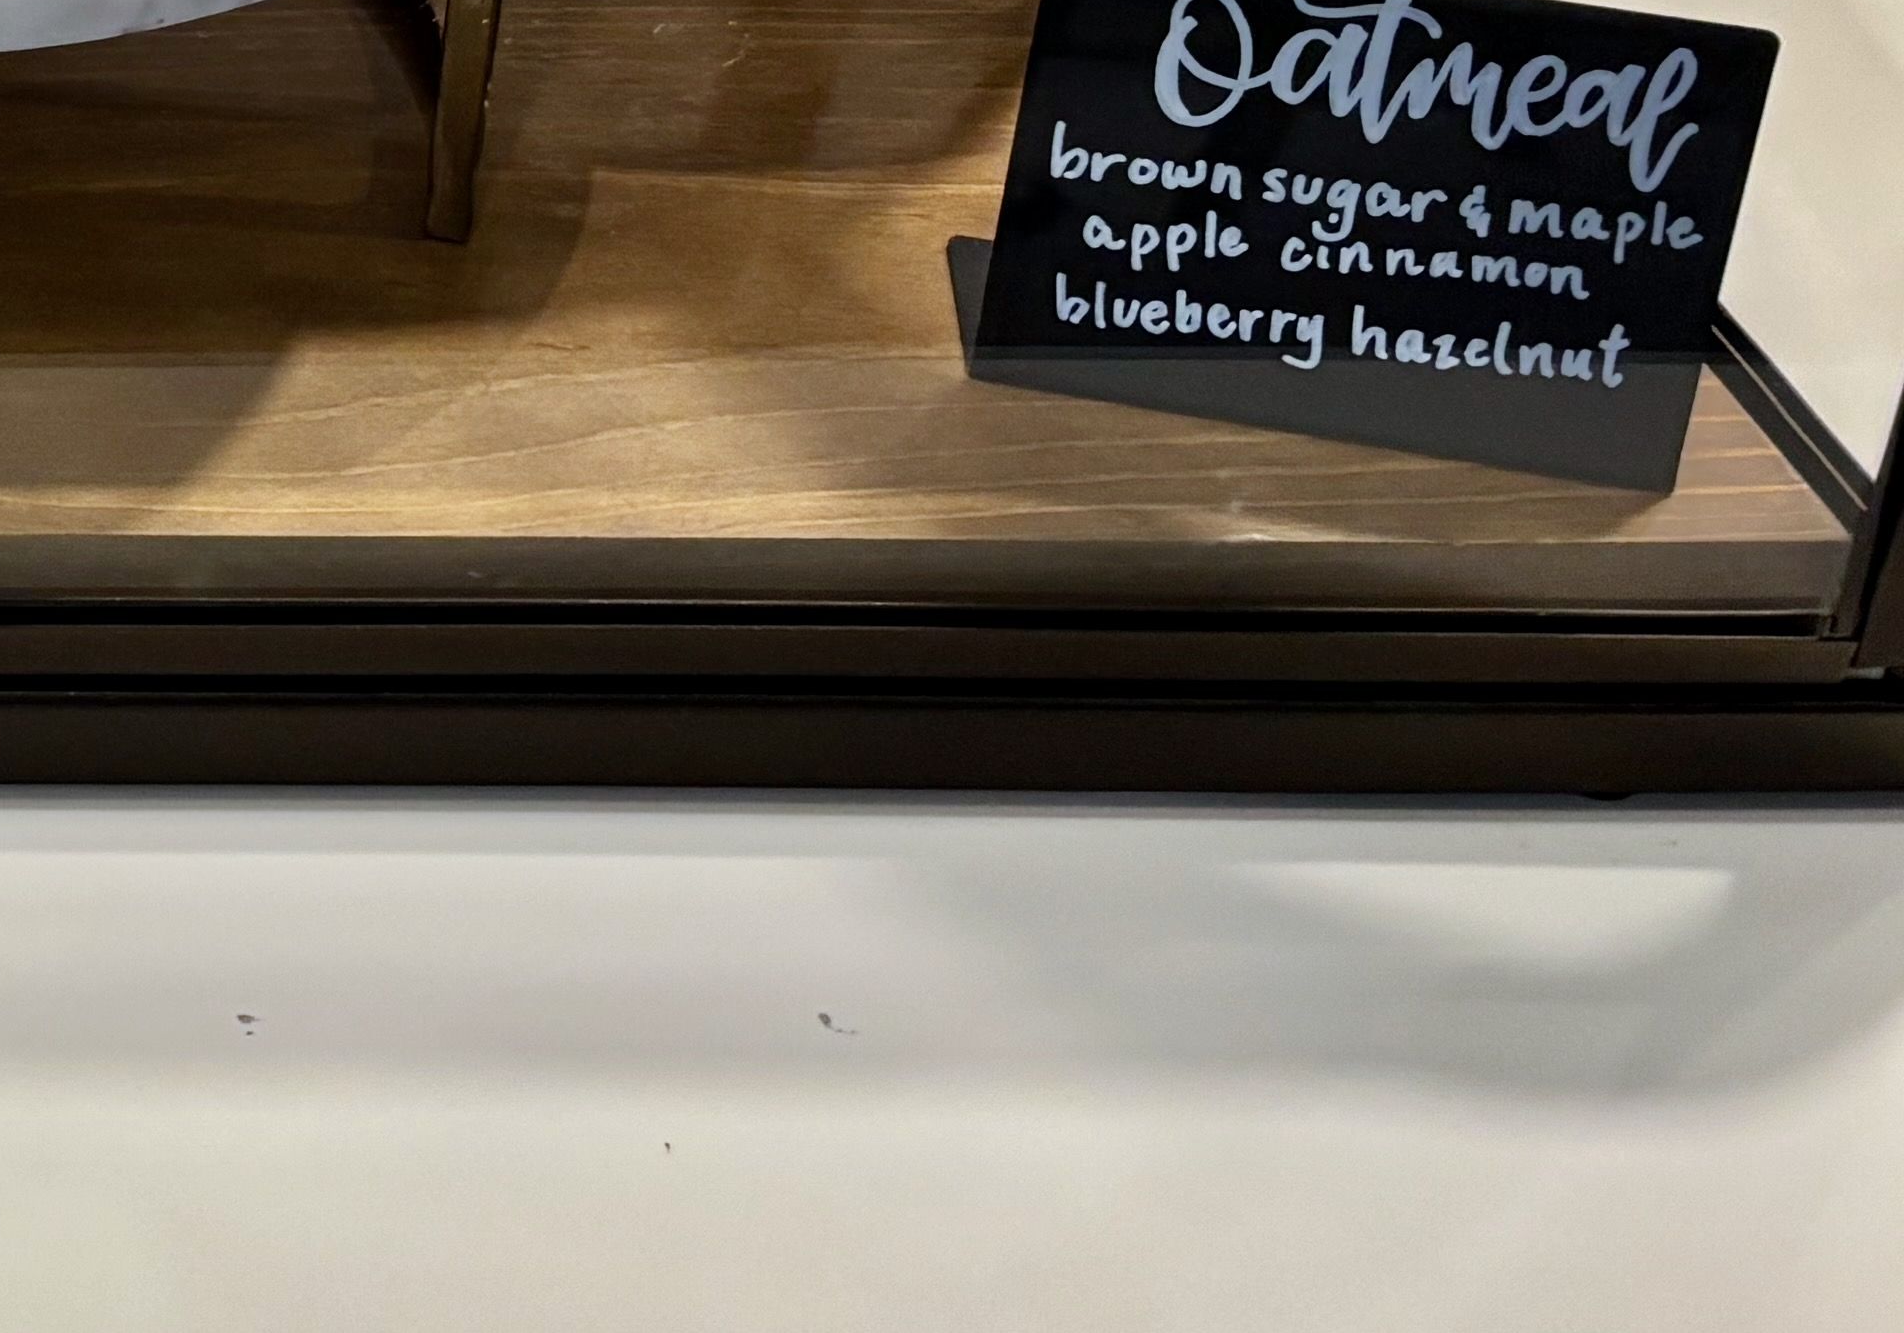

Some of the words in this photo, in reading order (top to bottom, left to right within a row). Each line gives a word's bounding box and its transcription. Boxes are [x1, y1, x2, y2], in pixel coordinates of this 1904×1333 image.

[1049, 120, 1243, 202] brown
[1262, 162, 1449, 242] sugar
[1459, 183, 1492, 239] &
[1508, 192, 1705, 265] maple
[1082, 210, 1250, 274] apple
[1279, 235, 1591, 302] cinnamon
[1054, 272, 1326, 369] blueberry
[1350, 304, 1632, 389] hazelnut
